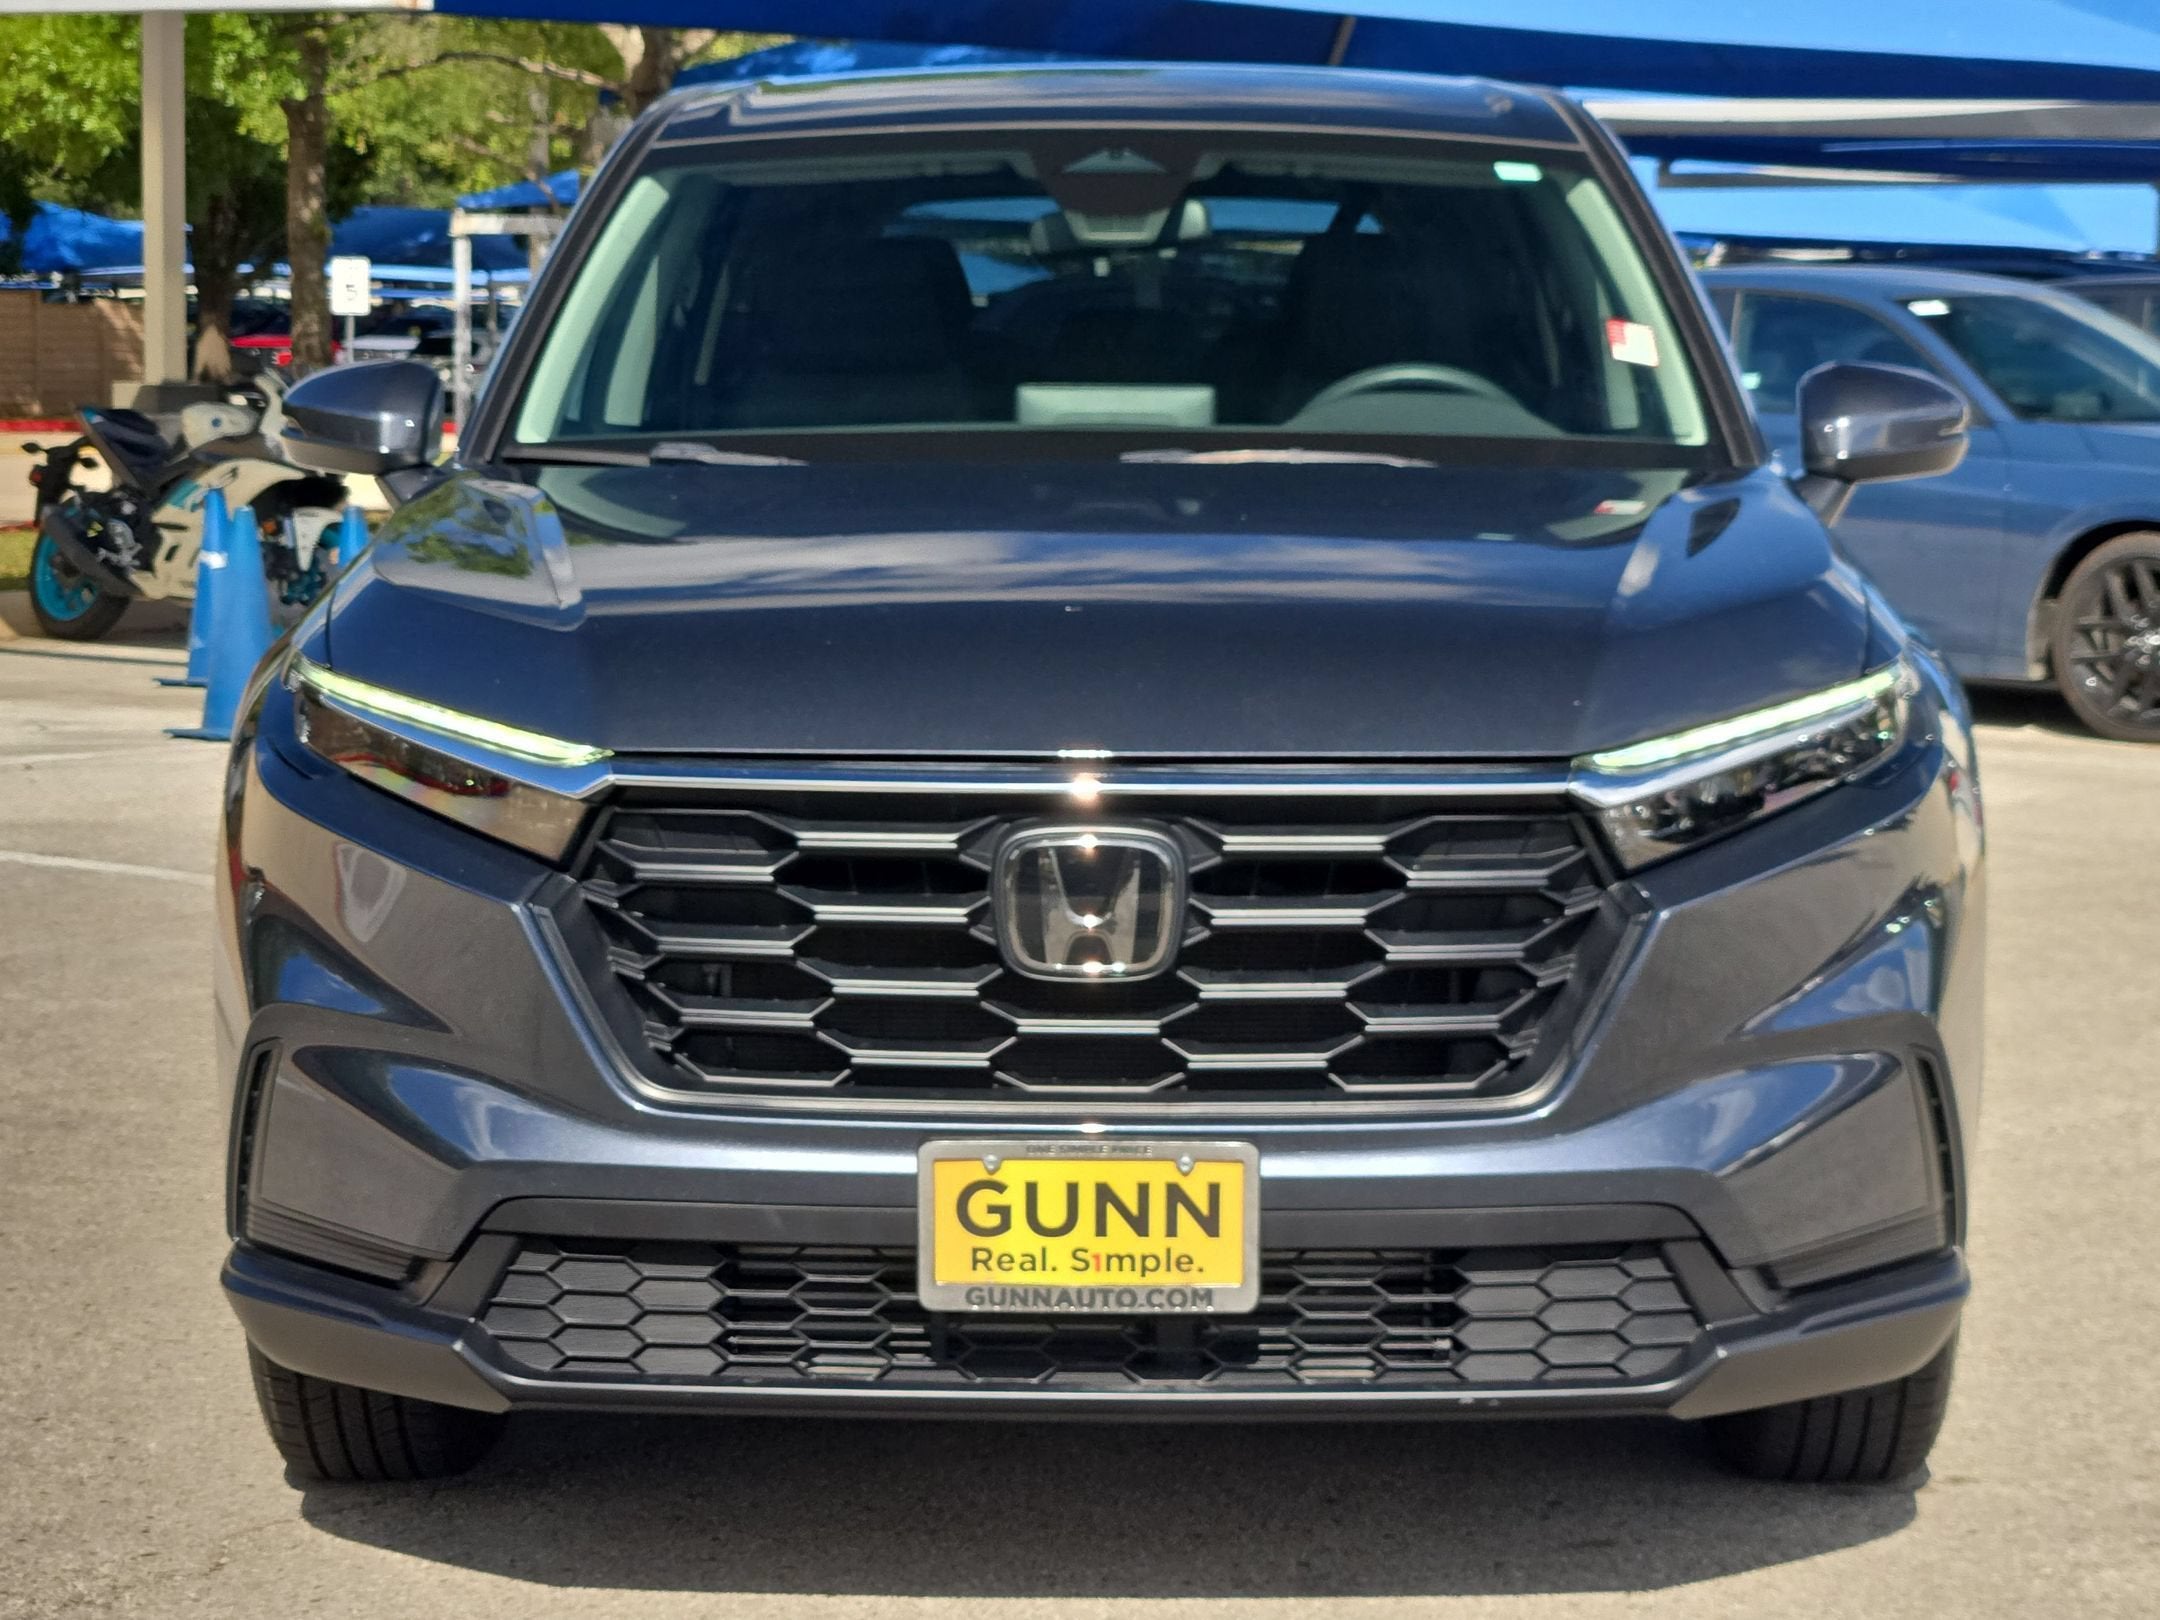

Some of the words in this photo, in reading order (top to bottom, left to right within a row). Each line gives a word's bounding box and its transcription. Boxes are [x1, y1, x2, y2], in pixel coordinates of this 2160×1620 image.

[956, 1179, 1220, 1238] GUNN
[971, 1247, 1057, 1272] Real.
[965, 1286, 1214, 1309] GUNNAUTO.COM
